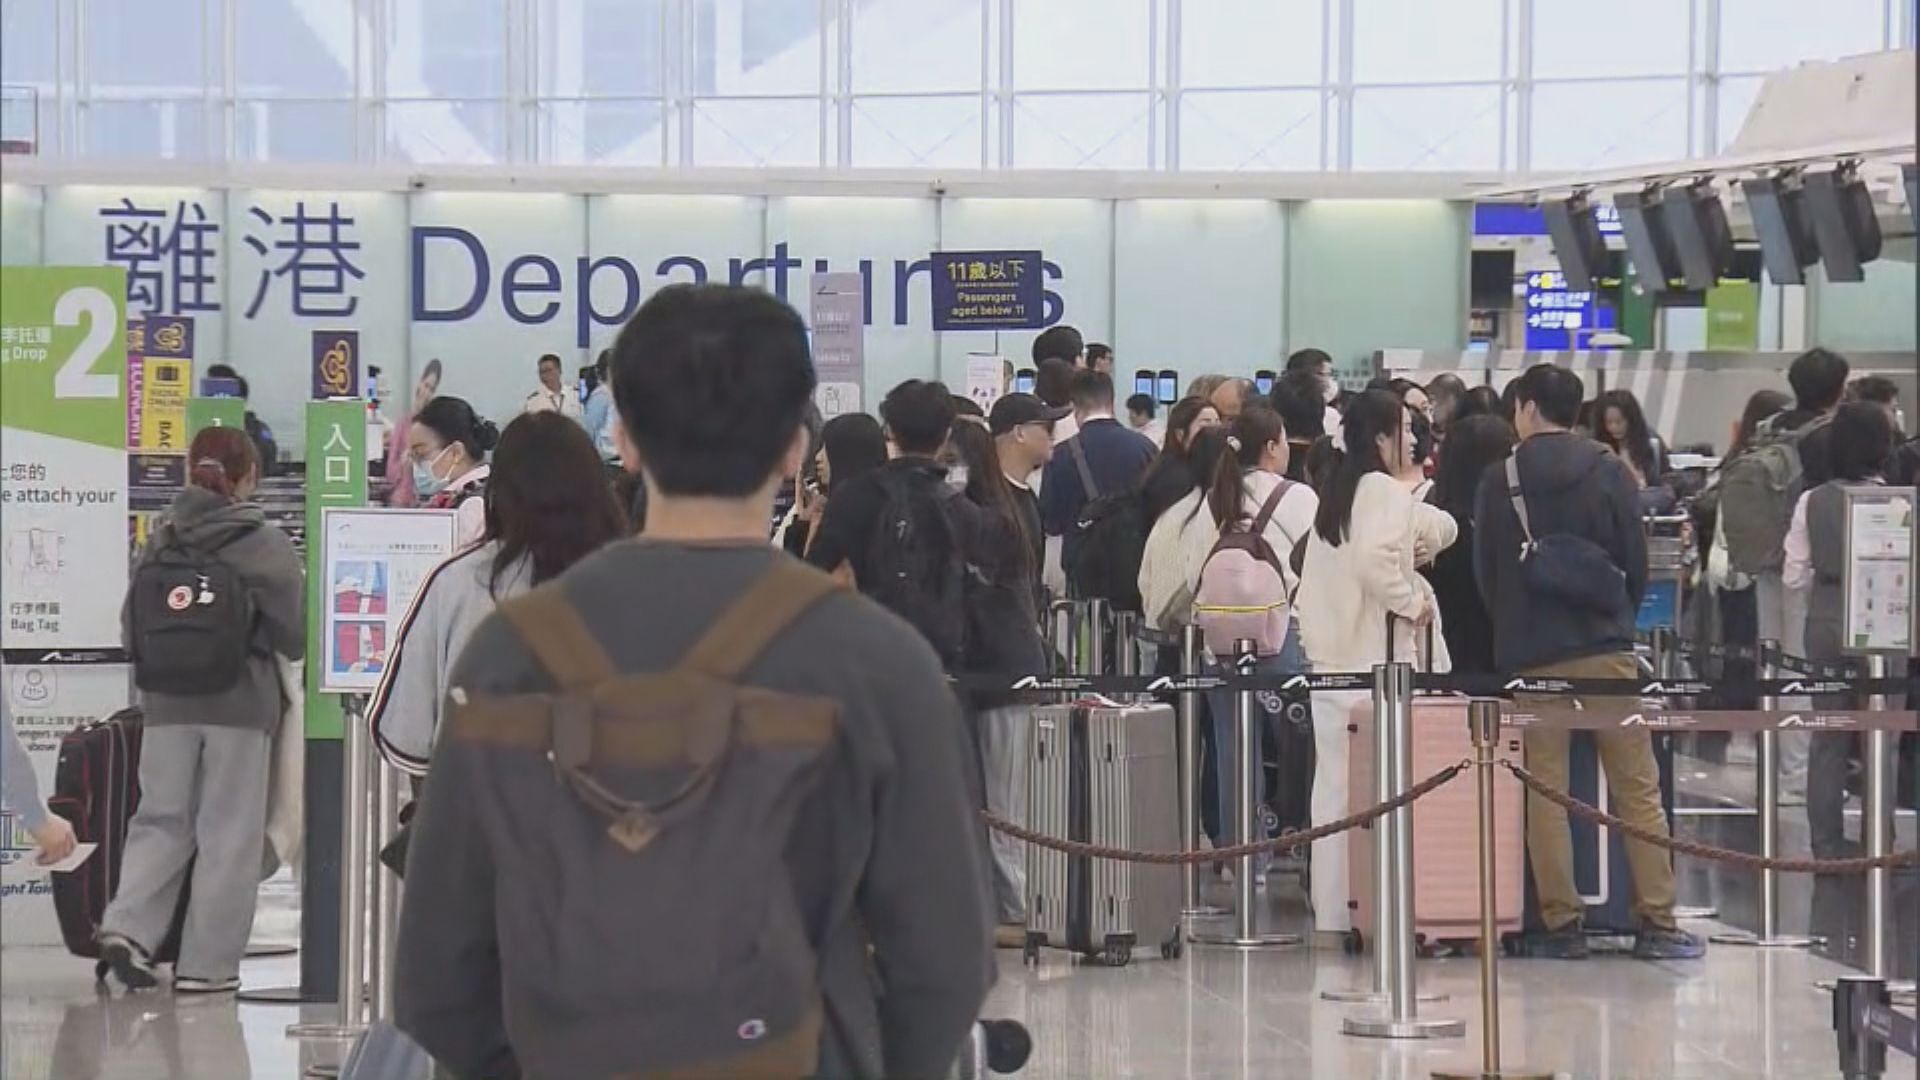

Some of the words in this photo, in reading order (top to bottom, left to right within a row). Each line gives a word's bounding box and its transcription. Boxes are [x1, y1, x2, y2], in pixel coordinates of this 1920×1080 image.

[99, 197, 366, 319] 離港
[947, 260, 1025, 280] 11歲以下
[957, 292, 1017, 304] Passengers
[951, 305, 978, 317] aged
[981, 304, 1012, 316] below
[54, 286, 119, 399] 2
[13, 346, 48, 363] Drop
[16, 486, 73, 504] attach
[77, 490, 117, 507] your
[10, 618, 35, 633] Bag
[37, 618, 59, 633] Tag
